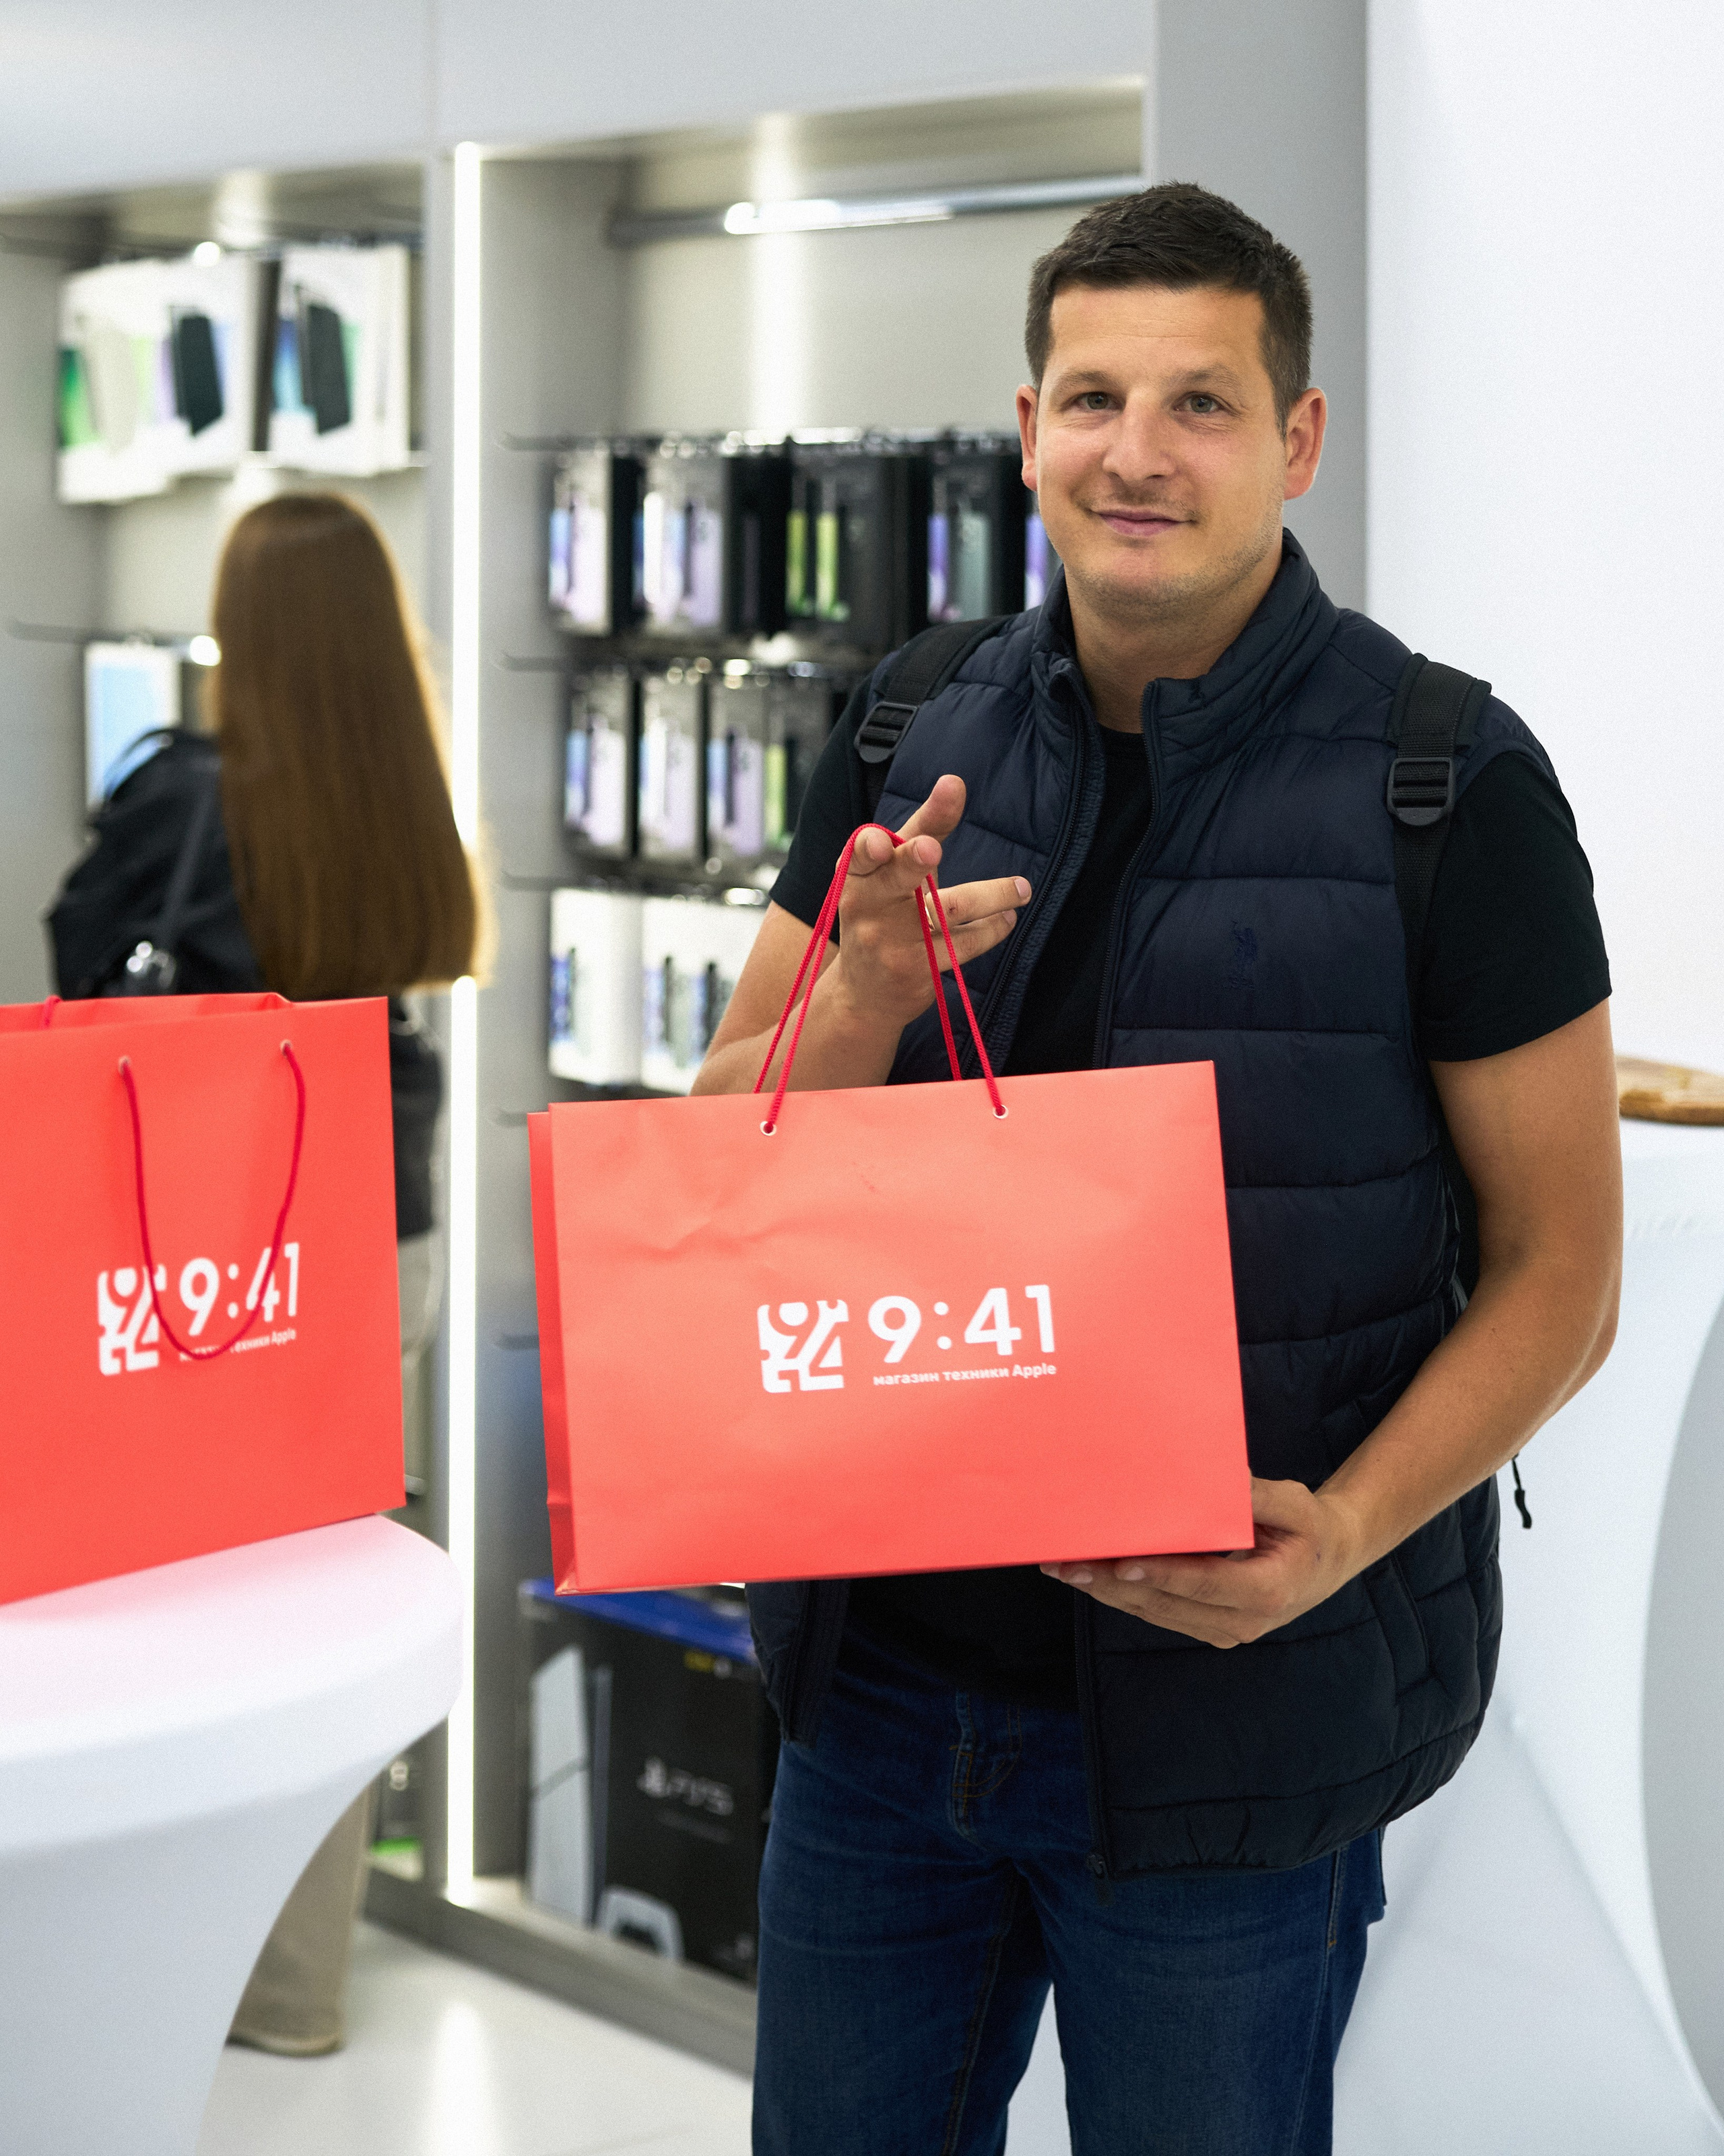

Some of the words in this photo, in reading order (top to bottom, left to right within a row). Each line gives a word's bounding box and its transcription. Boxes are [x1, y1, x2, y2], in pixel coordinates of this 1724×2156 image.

[180, 1242, 299, 1336] 9:41
[229, 1336, 269, 1353] ехники
[867, 1284, 1055, 1363] 9:41
[873, 1372, 939, 1386] магазин
[942, 1367, 1009, 1381] техники
[1012, 1362, 1057, 1379] Apple
